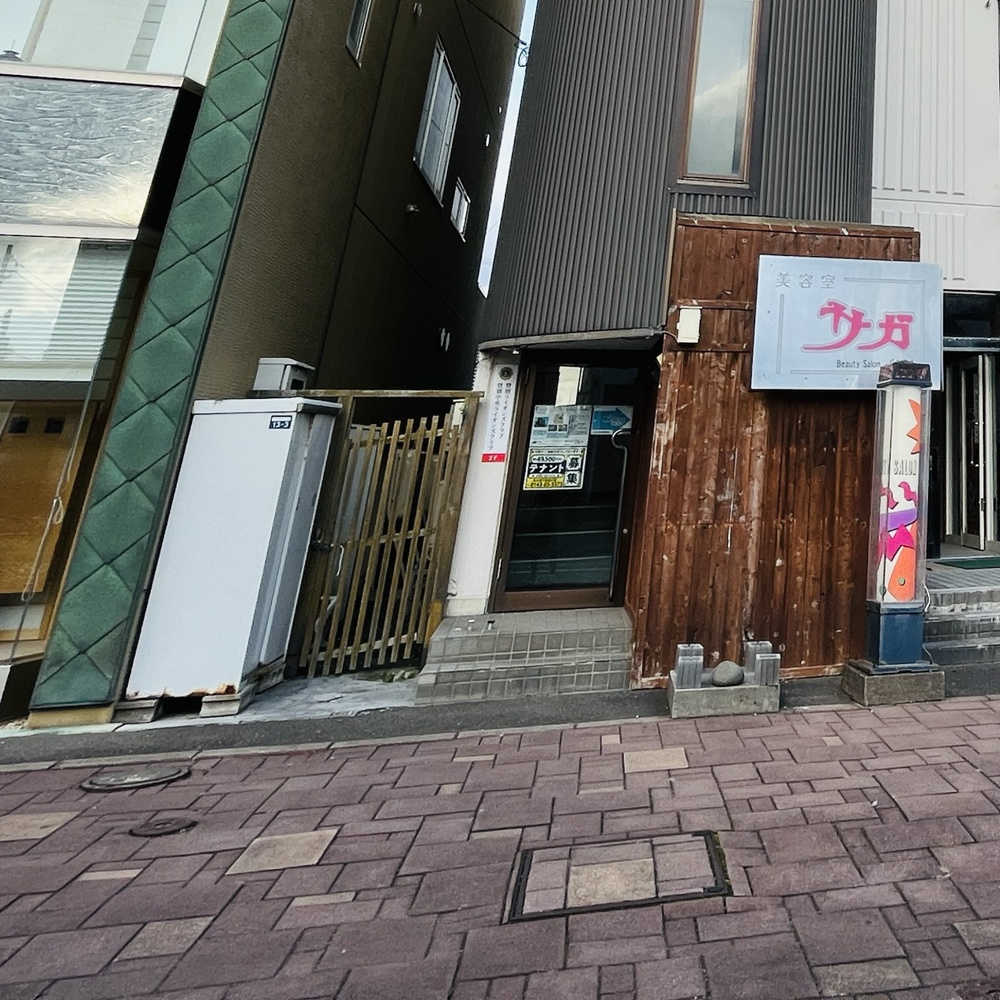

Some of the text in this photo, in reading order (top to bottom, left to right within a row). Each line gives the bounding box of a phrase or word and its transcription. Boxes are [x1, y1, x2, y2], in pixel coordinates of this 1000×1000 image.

[776, 272, 836, 289] 美容室
[803, 299, 914, 352] サガ
[836, 359, 861, 368] Beauty
[862, 359, 881, 368] Salon
[529, 463, 564, 473] テナント
